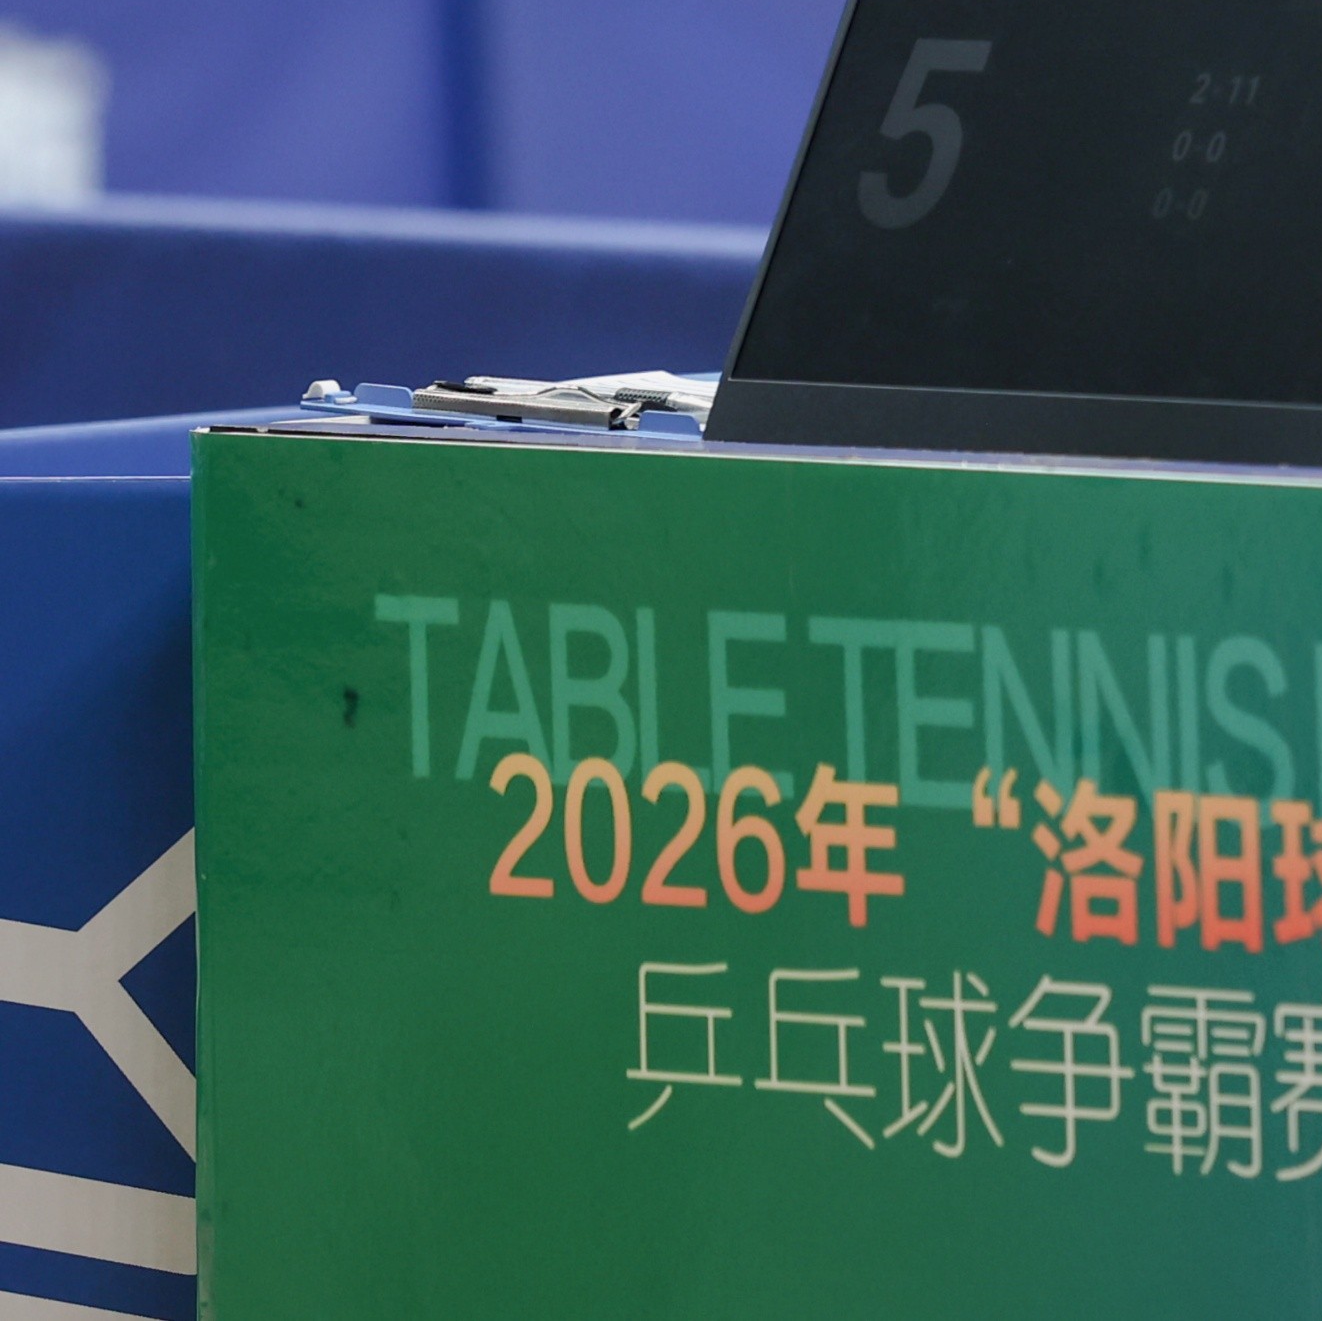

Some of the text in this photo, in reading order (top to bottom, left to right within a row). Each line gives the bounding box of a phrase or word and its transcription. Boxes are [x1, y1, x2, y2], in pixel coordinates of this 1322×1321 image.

[856, 38, 993, 231] 5
[375, 593, 795, 800] TABLE
[808, 615, 1294, 830] TENNIS
